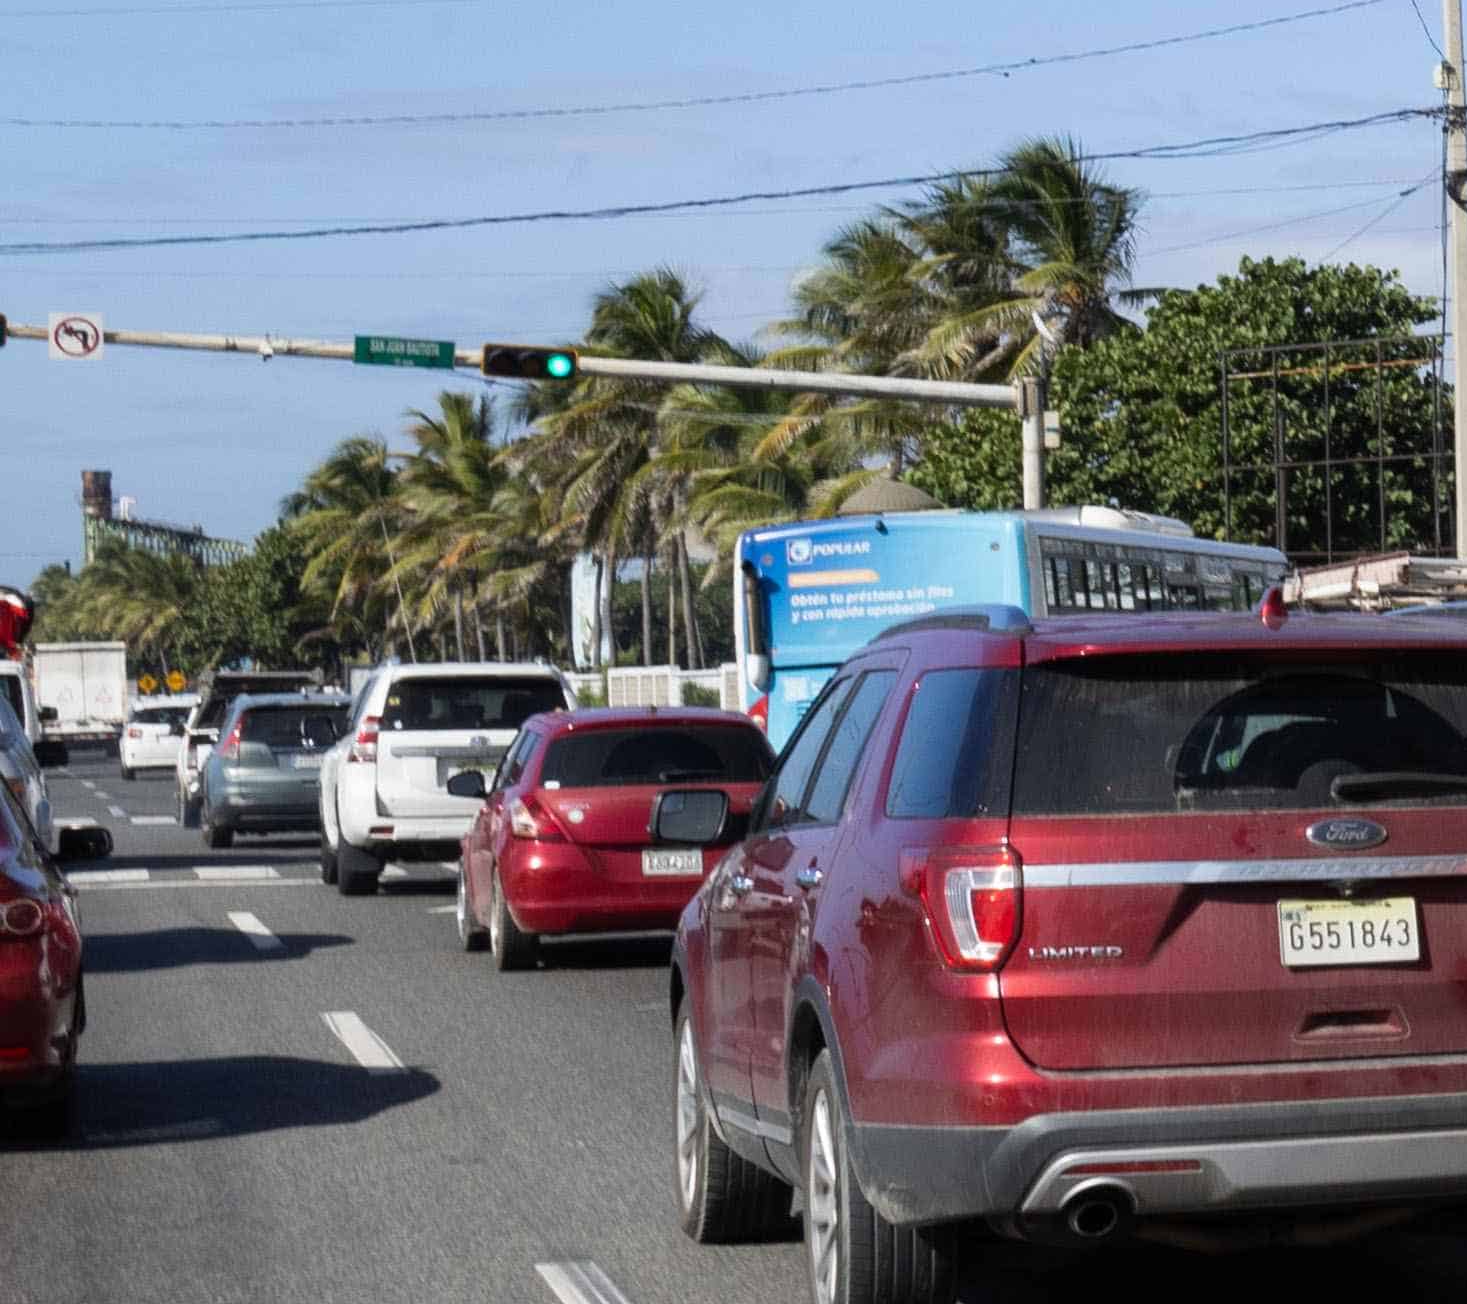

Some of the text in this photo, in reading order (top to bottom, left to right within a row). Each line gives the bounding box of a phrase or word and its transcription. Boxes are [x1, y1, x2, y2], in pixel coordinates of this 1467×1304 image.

[813, 540, 871, 556] POPULAR
[906, 588, 924, 599] sin
[802, 609, 823, 621] con
[1325, 822, 1369, 841] Ford
[1289, 918, 1411, 951] G551843
[1028, 946, 1122, 958] LIMITED
